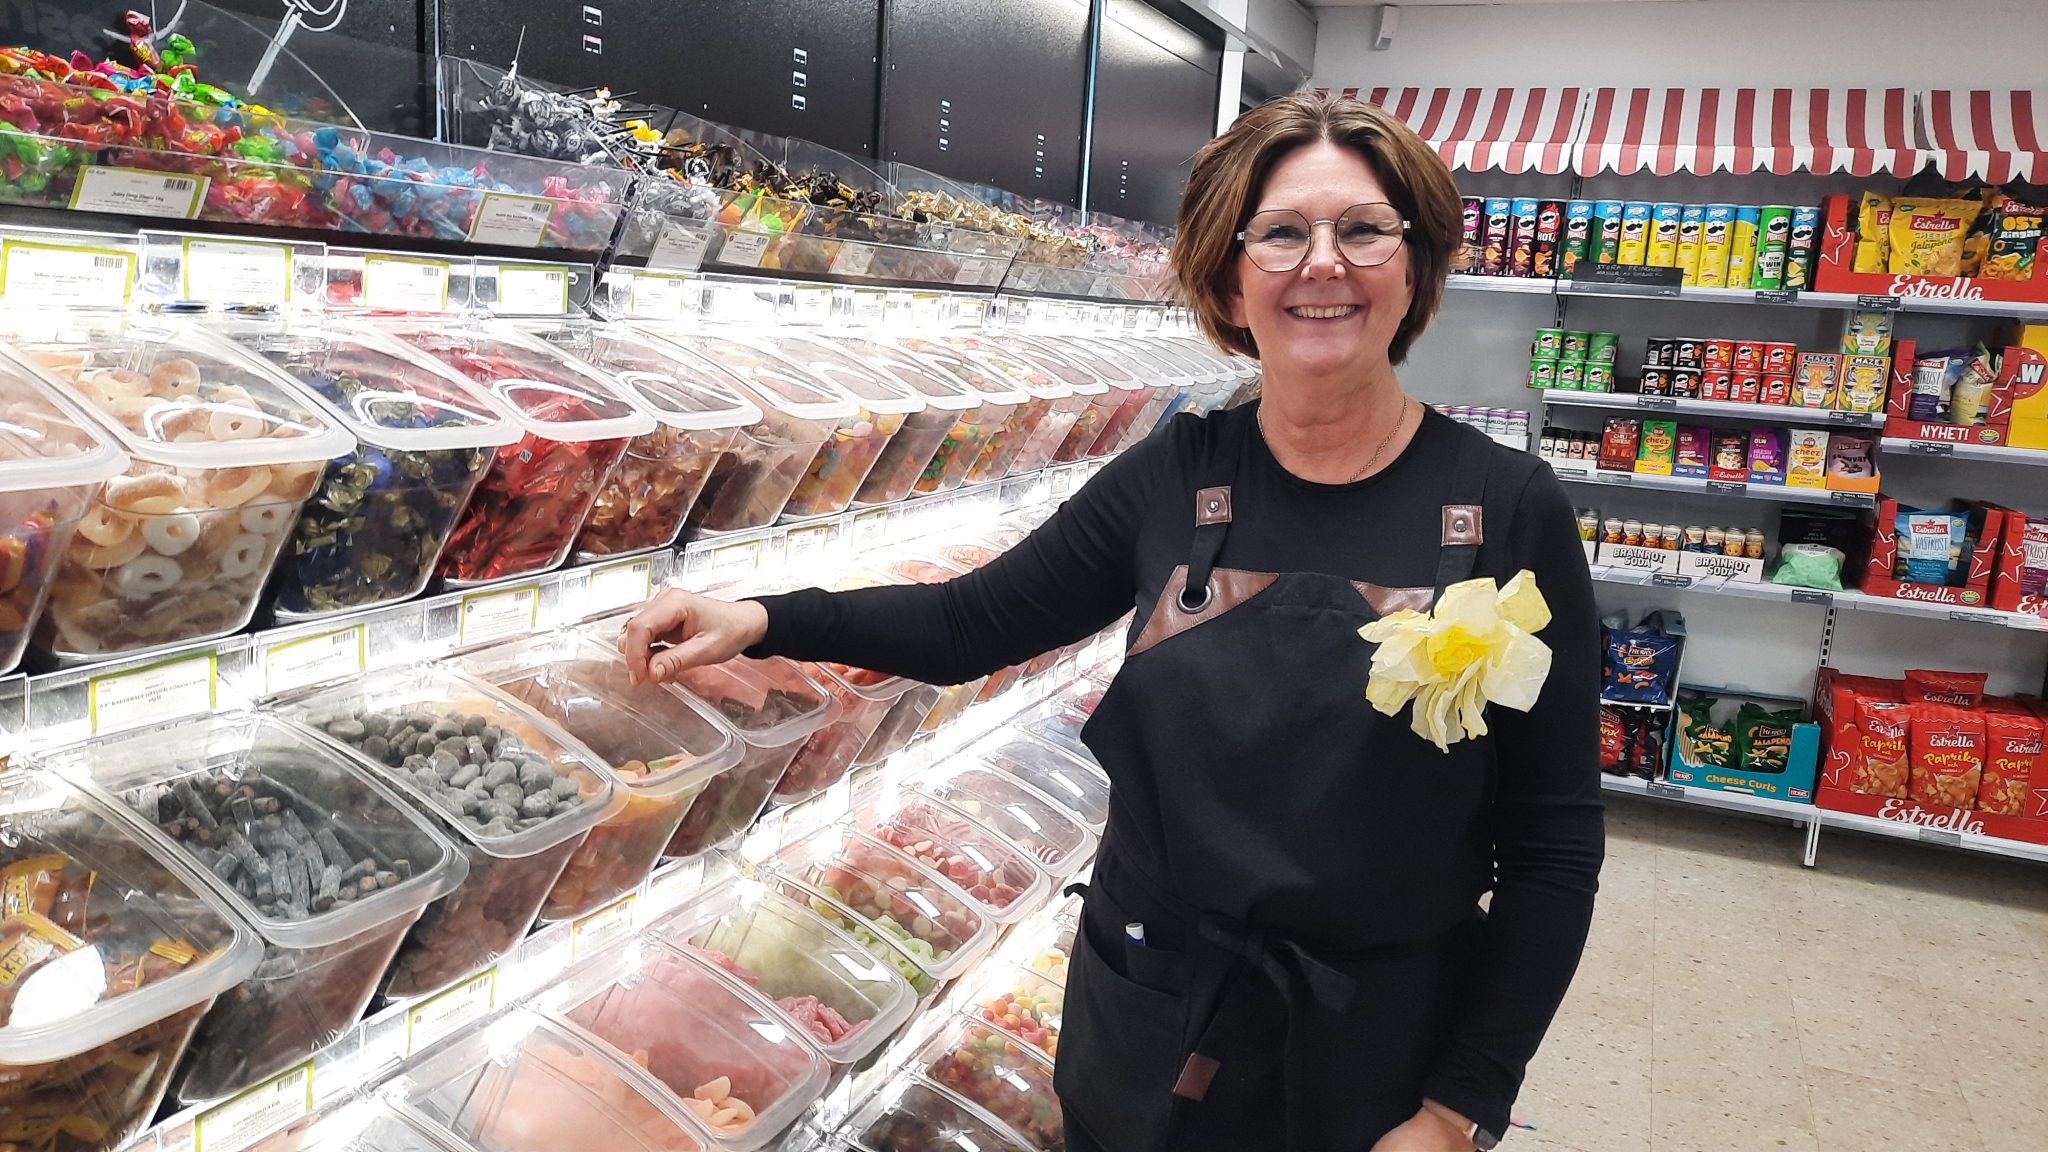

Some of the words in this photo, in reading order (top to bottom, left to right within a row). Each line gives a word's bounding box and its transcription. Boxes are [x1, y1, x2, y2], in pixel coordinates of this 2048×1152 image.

[1914, 218, 1955, 231] Estrella
[2003, 216, 2043, 230] OST
[1537, 233, 1552, 241] HOT
[1888, 275, 1985, 300] Estrella
[1854, 358, 1882, 366] MAZE
[1920, 424, 1970, 441] NYHET!
[1795, 448, 1821, 457] cheez
[1719, 470, 1745, 479] Estrella
[1914, 525, 1945, 534] Estrella
[1613, 547, 1667, 564] BRAINROT
[1624, 556, 1652, 569] SODA
[1695, 556, 1751, 574] BRAINROT
[1707, 565, 1735, 577] SODA
[1896, 582, 1957, 604] Estrella
[1930, 734, 1975, 748] Estrella
[2006, 740, 2043, 754] Estrell
[1923, 750, 1982, 768] Paprika
[1705, 774, 1746, 787] Cheese
[1749, 780, 1777, 793] Curls
[1877, 798, 1987, 836] Estrella
